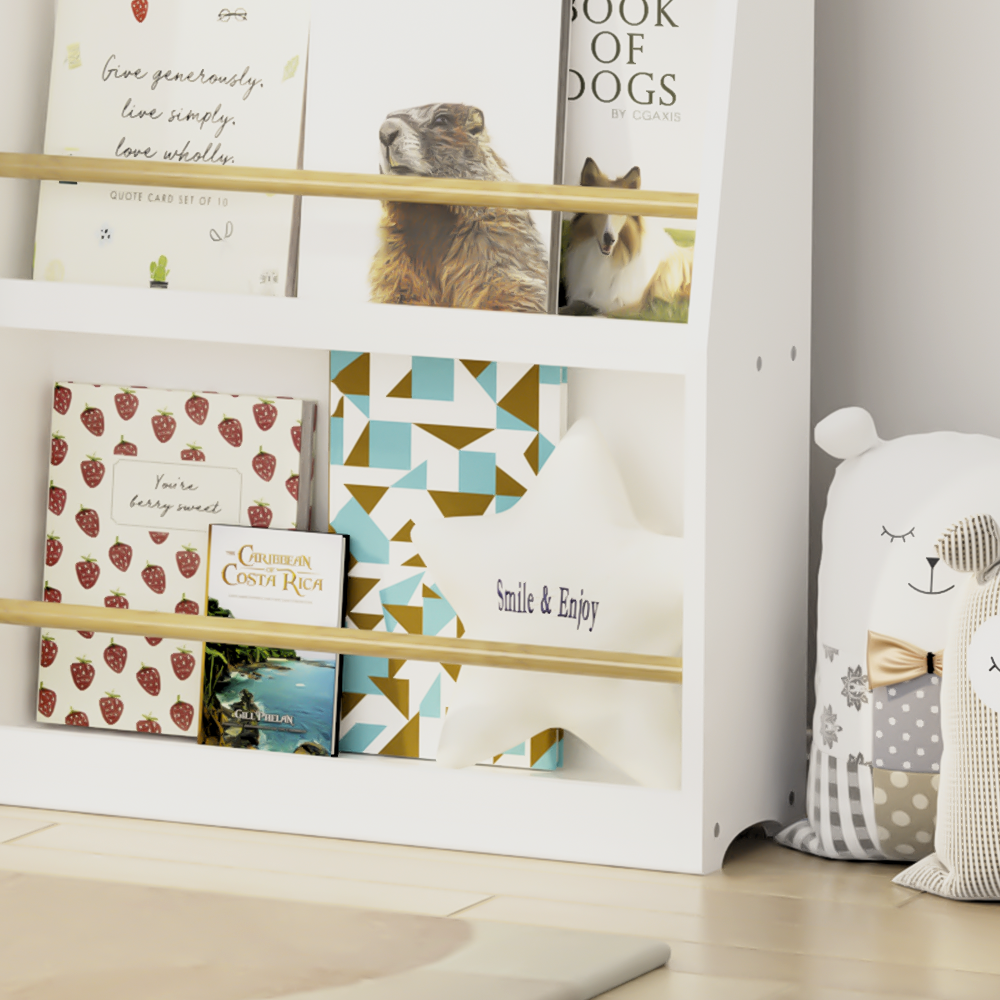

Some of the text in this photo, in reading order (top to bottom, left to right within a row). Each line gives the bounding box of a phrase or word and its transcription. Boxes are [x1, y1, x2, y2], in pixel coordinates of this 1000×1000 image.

[591, 31, 645, 65] OF
[101, 54, 264, 101] Give generously.
[121, 97, 236, 139] live simply.
[611, 108, 682, 122] BY CGAXIS
[115, 136, 158, 159] love
[110, 190, 229, 207] QUOTE CARD SET OF 10
[155, 473, 198, 491] You're
[129, 494, 222, 518] berry sweet
[238, 544, 313, 570] CARIBBEAN
[221, 563, 324, 597] COSTA RICA
[497, 579, 600, 632] Smile & Enjoy
[257, 711, 295, 726] PHELAN
